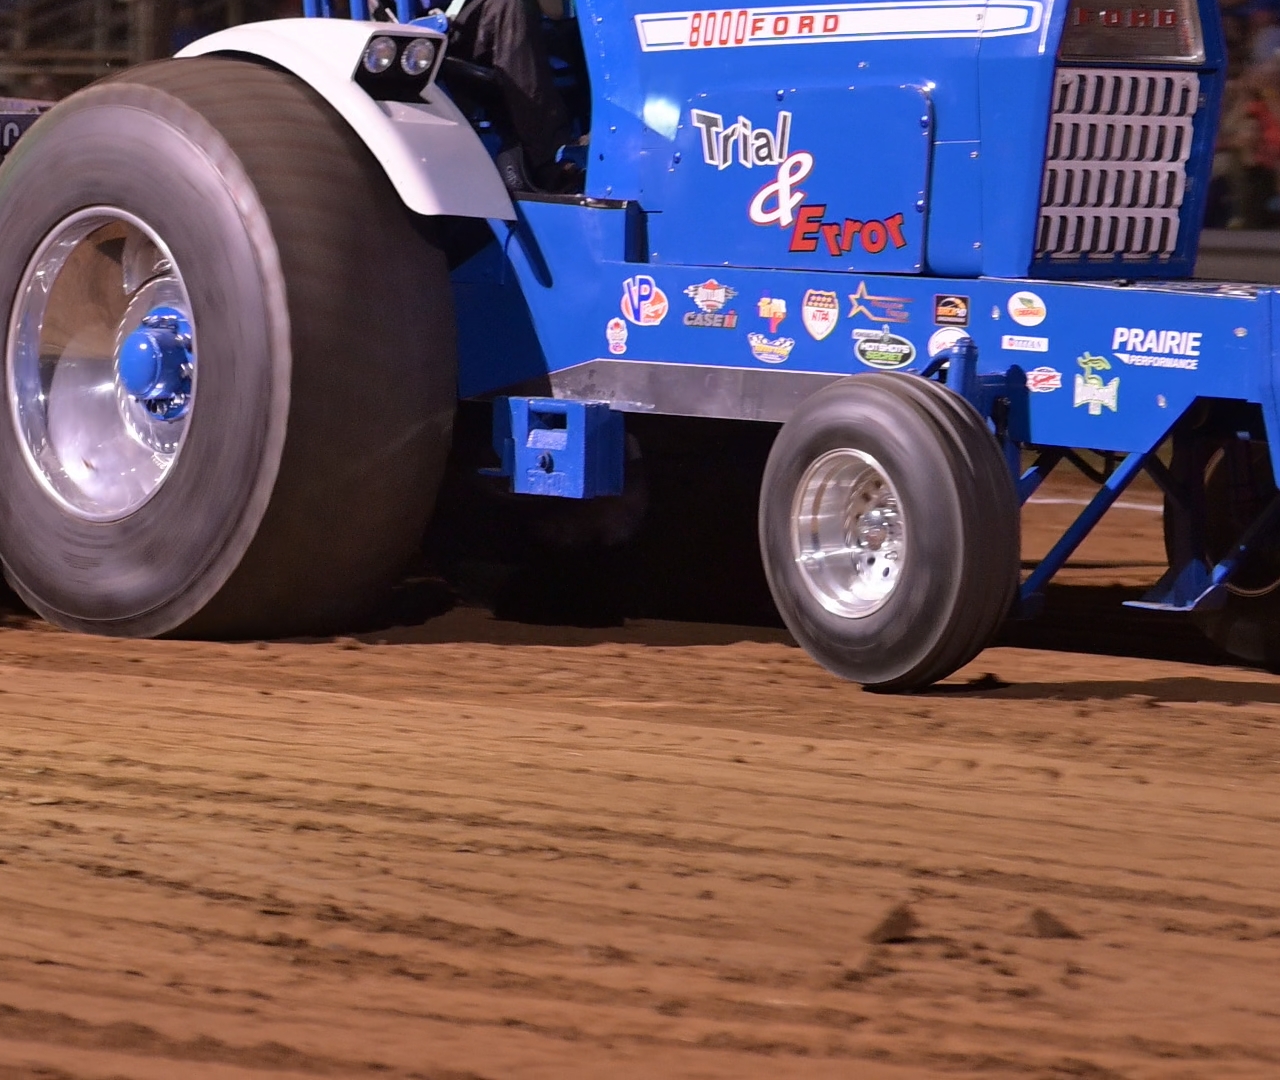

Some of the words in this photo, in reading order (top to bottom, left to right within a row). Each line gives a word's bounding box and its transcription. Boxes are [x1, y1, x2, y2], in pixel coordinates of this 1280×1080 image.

[689, 10, 749, 47] 8000
[751, 14, 840, 36] FORD
[691, 108, 792, 171] Trial
[748, 150, 815, 229] &
[788, 203, 907, 257] Error
[683, 311, 722, 327] CASE
[1111, 326, 1203, 356] PRAIRIE
[1128, 355, 1200, 370] PERFORMANCE
